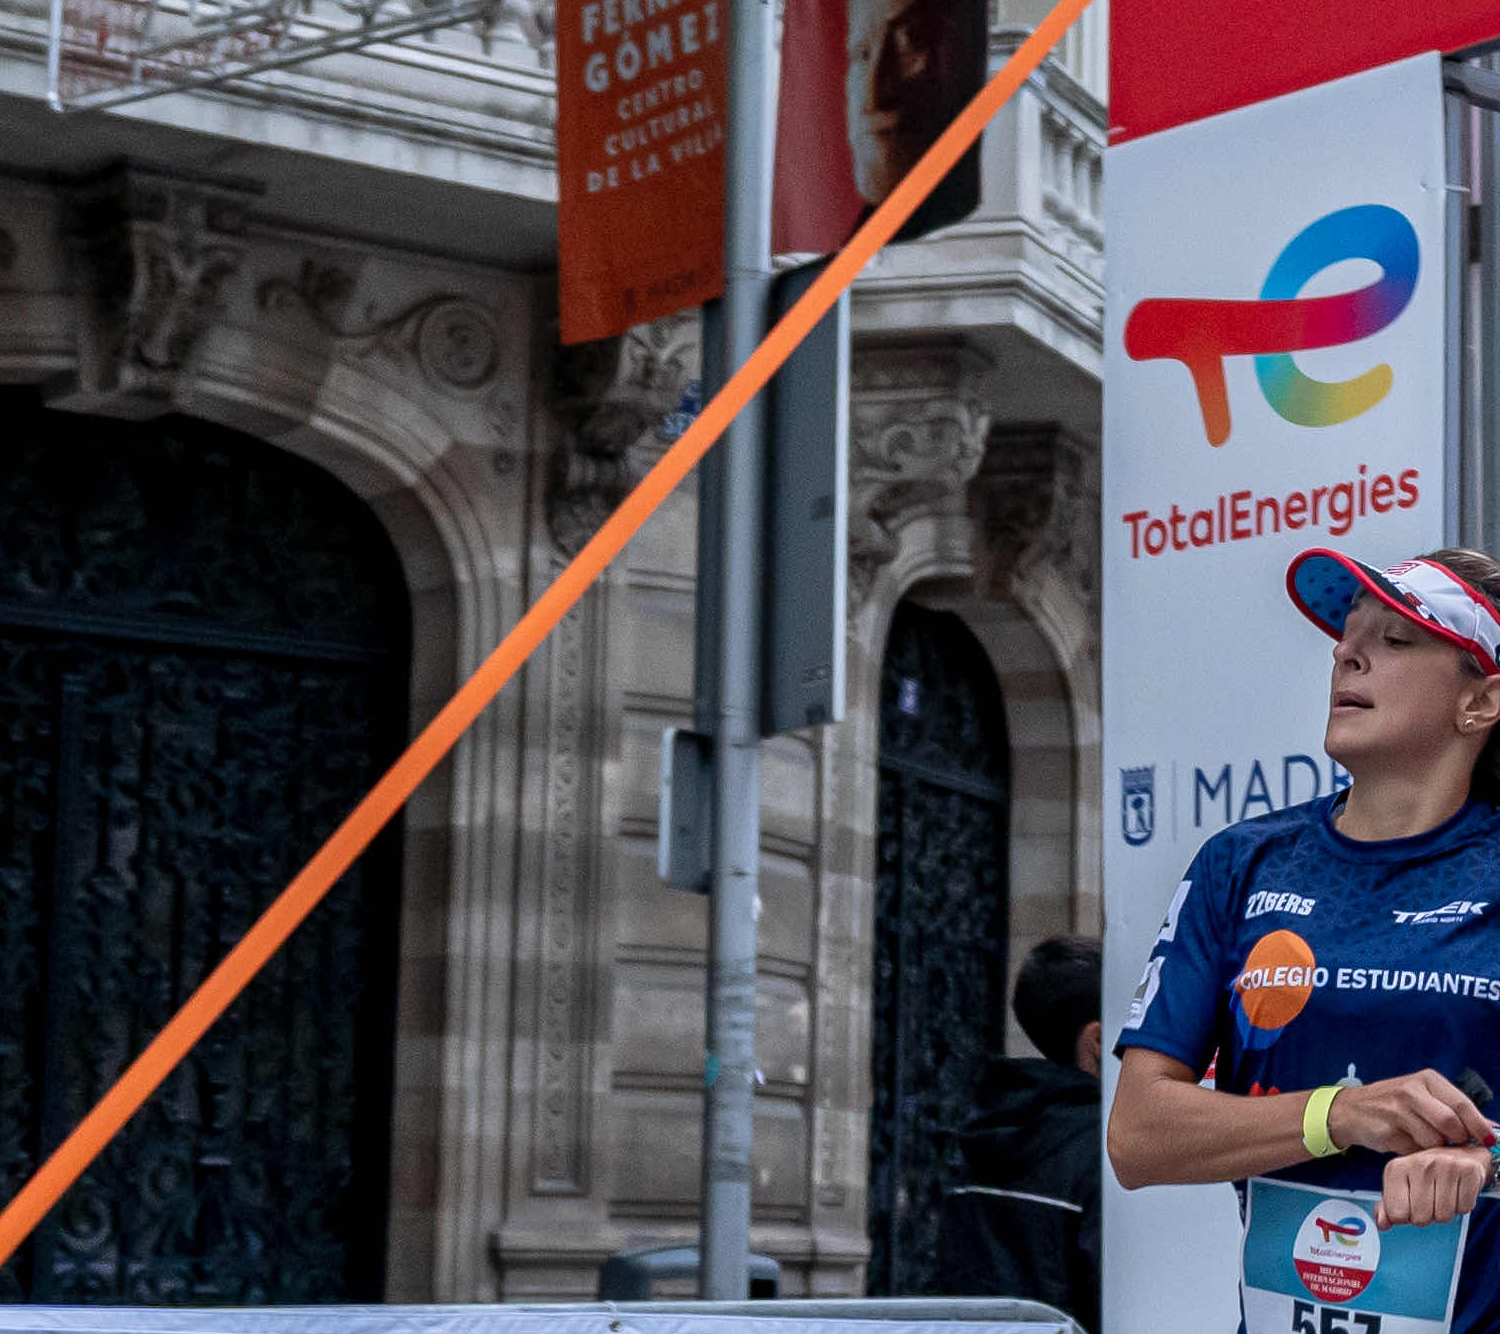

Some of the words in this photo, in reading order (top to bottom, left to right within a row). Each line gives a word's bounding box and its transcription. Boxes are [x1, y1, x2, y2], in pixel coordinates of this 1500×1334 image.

[584, 2, 720, 93] GÓMEZ
[617, 69, 704, 120] CENTRO
[587, 166, 619, 193] DE
[632, 154, 661, 181] LA
[1122, 465, 1421, 559] TotalEnergies
[1392, 900, 1490, 924] TREK
[1240, 966, 1329, 990] COLEGIO
